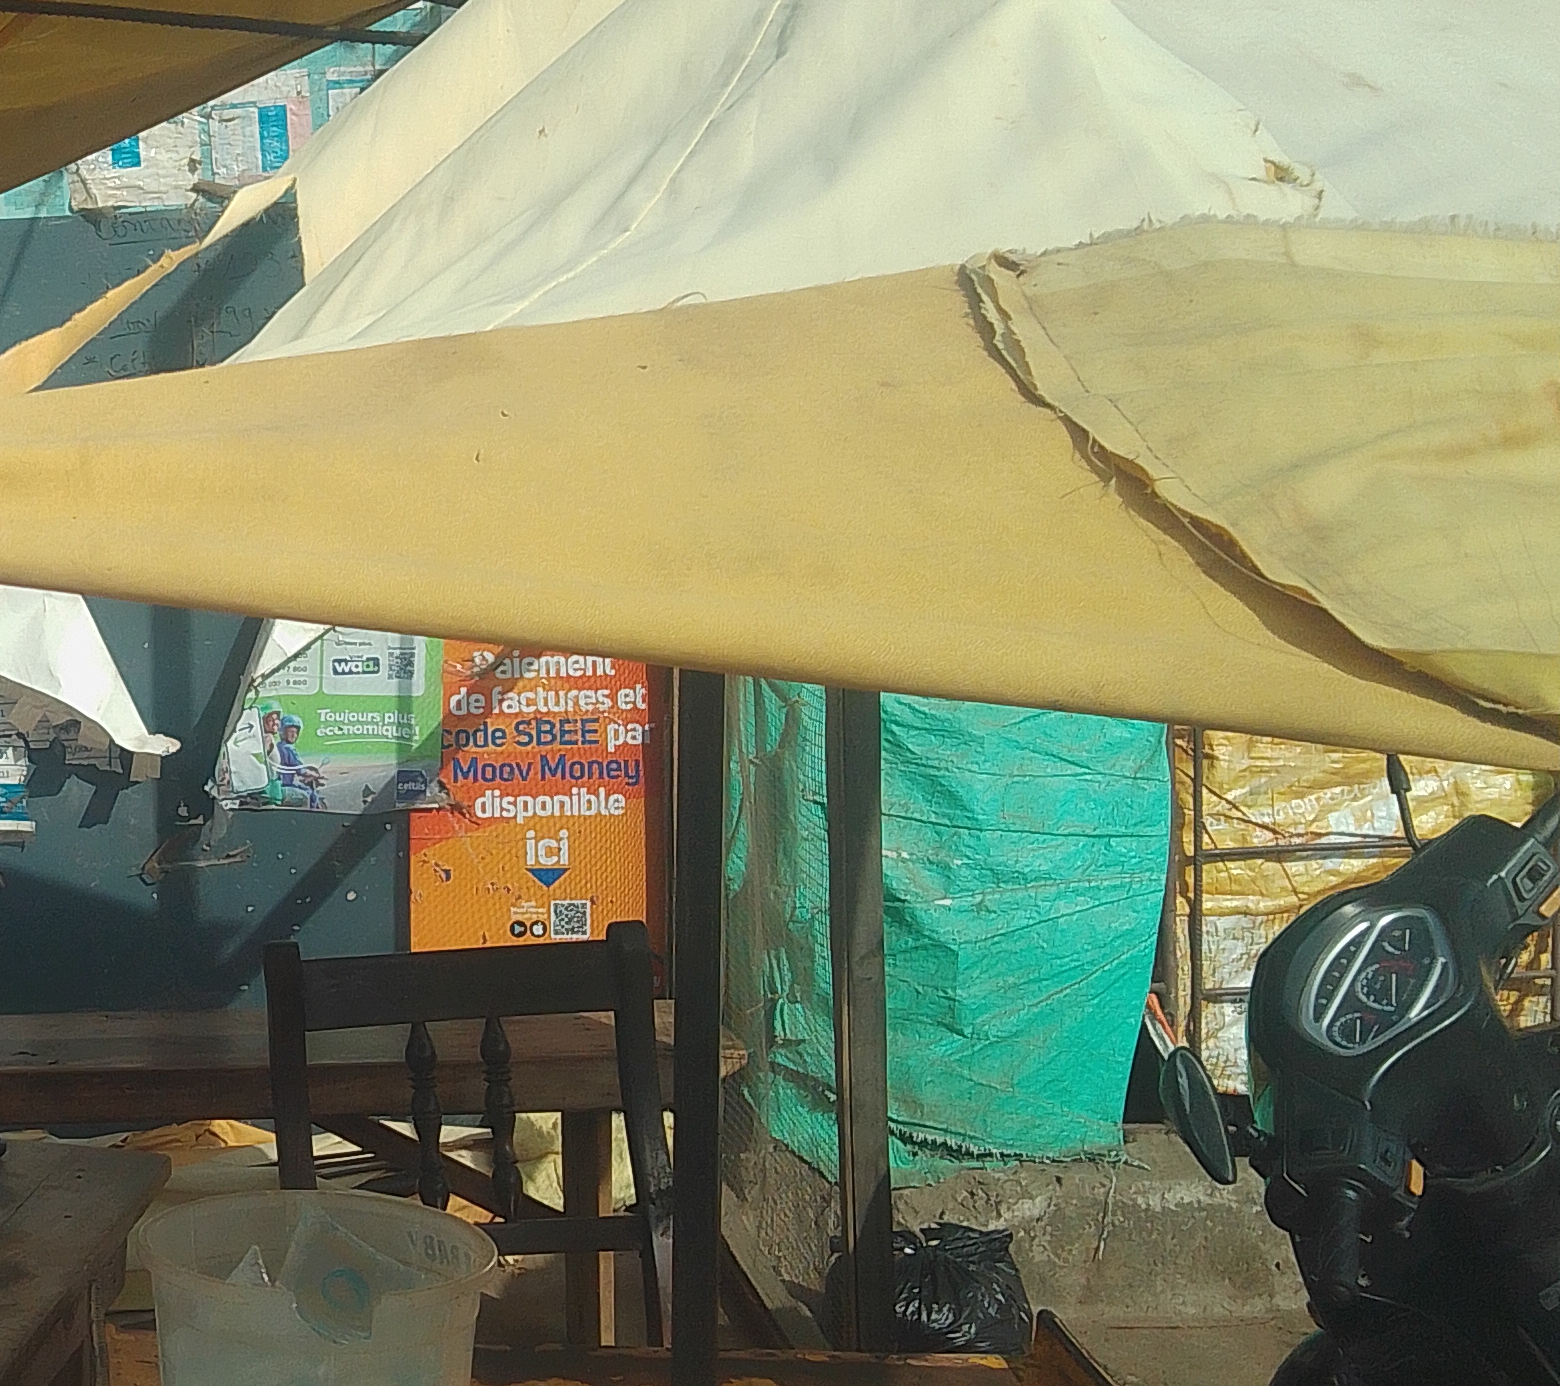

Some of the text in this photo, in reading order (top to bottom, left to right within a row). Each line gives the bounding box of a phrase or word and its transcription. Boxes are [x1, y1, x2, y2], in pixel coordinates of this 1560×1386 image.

[317, 708, 415, 725] Toujours plus
[450, 683, 648, 716] de factures et
[442, 717, 656, 753] code SBEE par
[452, 753, 641, 787] Moov Money
[474, 785, 627, 824] disponible
[525, 828, 570, 866] ici
